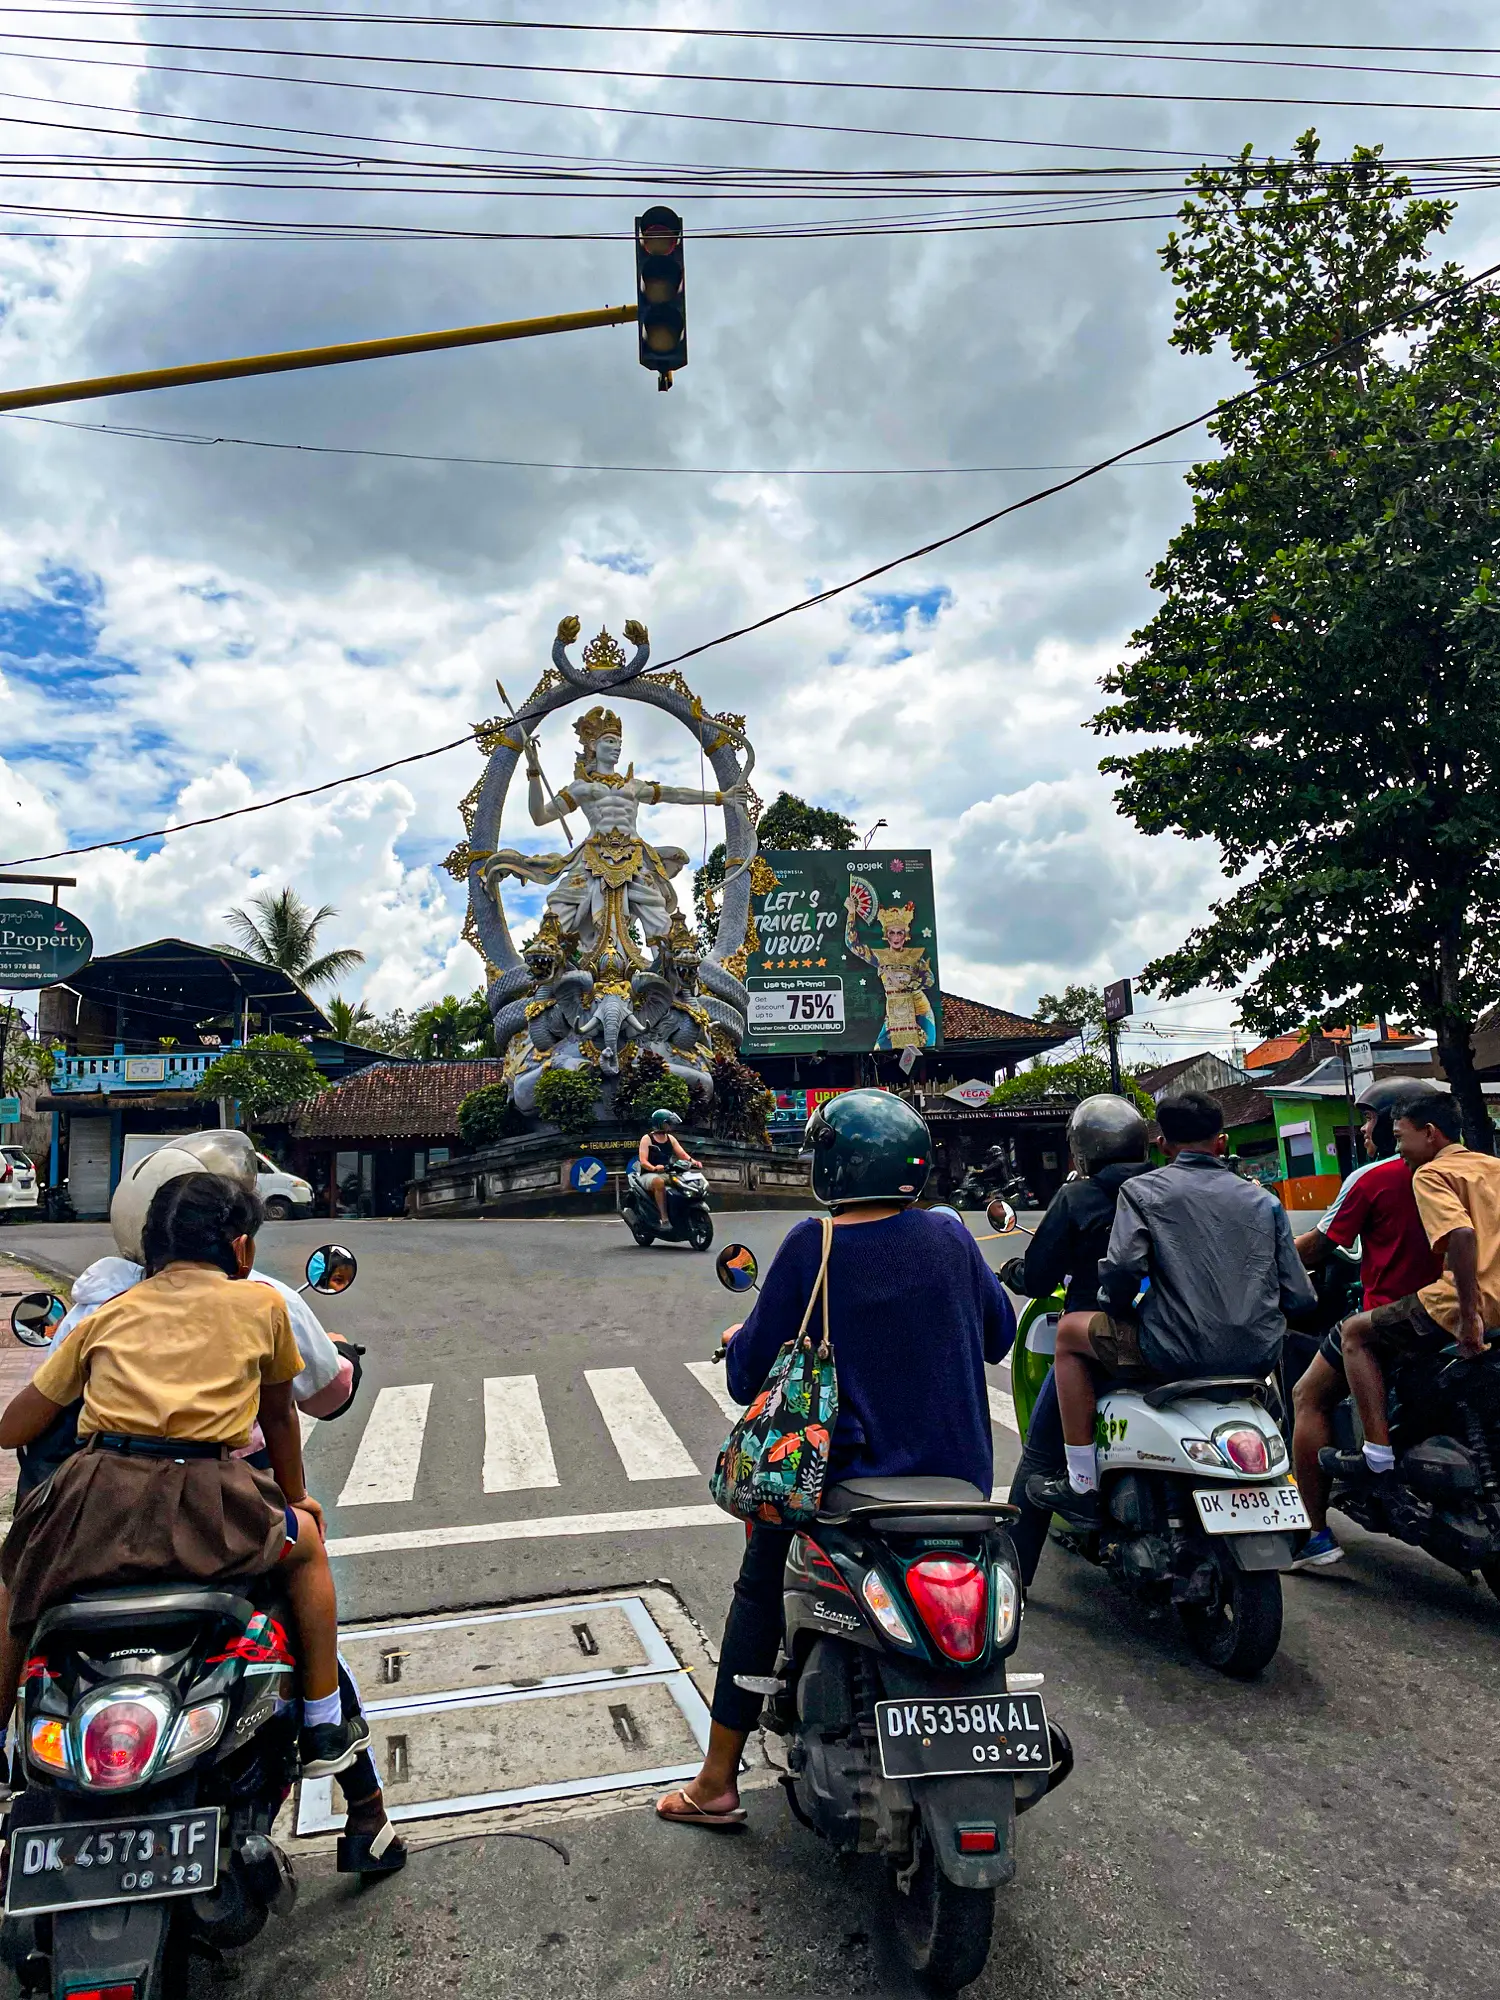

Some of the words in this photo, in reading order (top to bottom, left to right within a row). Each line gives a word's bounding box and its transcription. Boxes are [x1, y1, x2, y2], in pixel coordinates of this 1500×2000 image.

[856, 862, 883, 871] gojek
[764, 890, 820, 913] LET'S
[754, 913, 811, 933] TRAVEL
[816, 912, 838, 931] TO
[2, 930, 87, 952] Property
[764, 933, 824, 956] UBUD!
[763, 981, 779, 989] Use
[780, 981, 795, 989] the
[796, 980, 826, 988] Promo!
[788, 1023, 841, 1031] GOJEKINUBUD
[960, 1090, 991, 1098] VEGAS
[1200, 1495, 1223, 1512] DK
[1231, 1492, 1270, 1510] 4838
[923, 1539, 961, 1547] HONDA
[813, 1601, 861, 1631] Scoopy
[110, 1648, 156, 1658] HONDA
[23, 1837, 65, 1874] DK
[75, 1829, 155, 1868] 4573
[168, 1820, 206, 1856] TF
